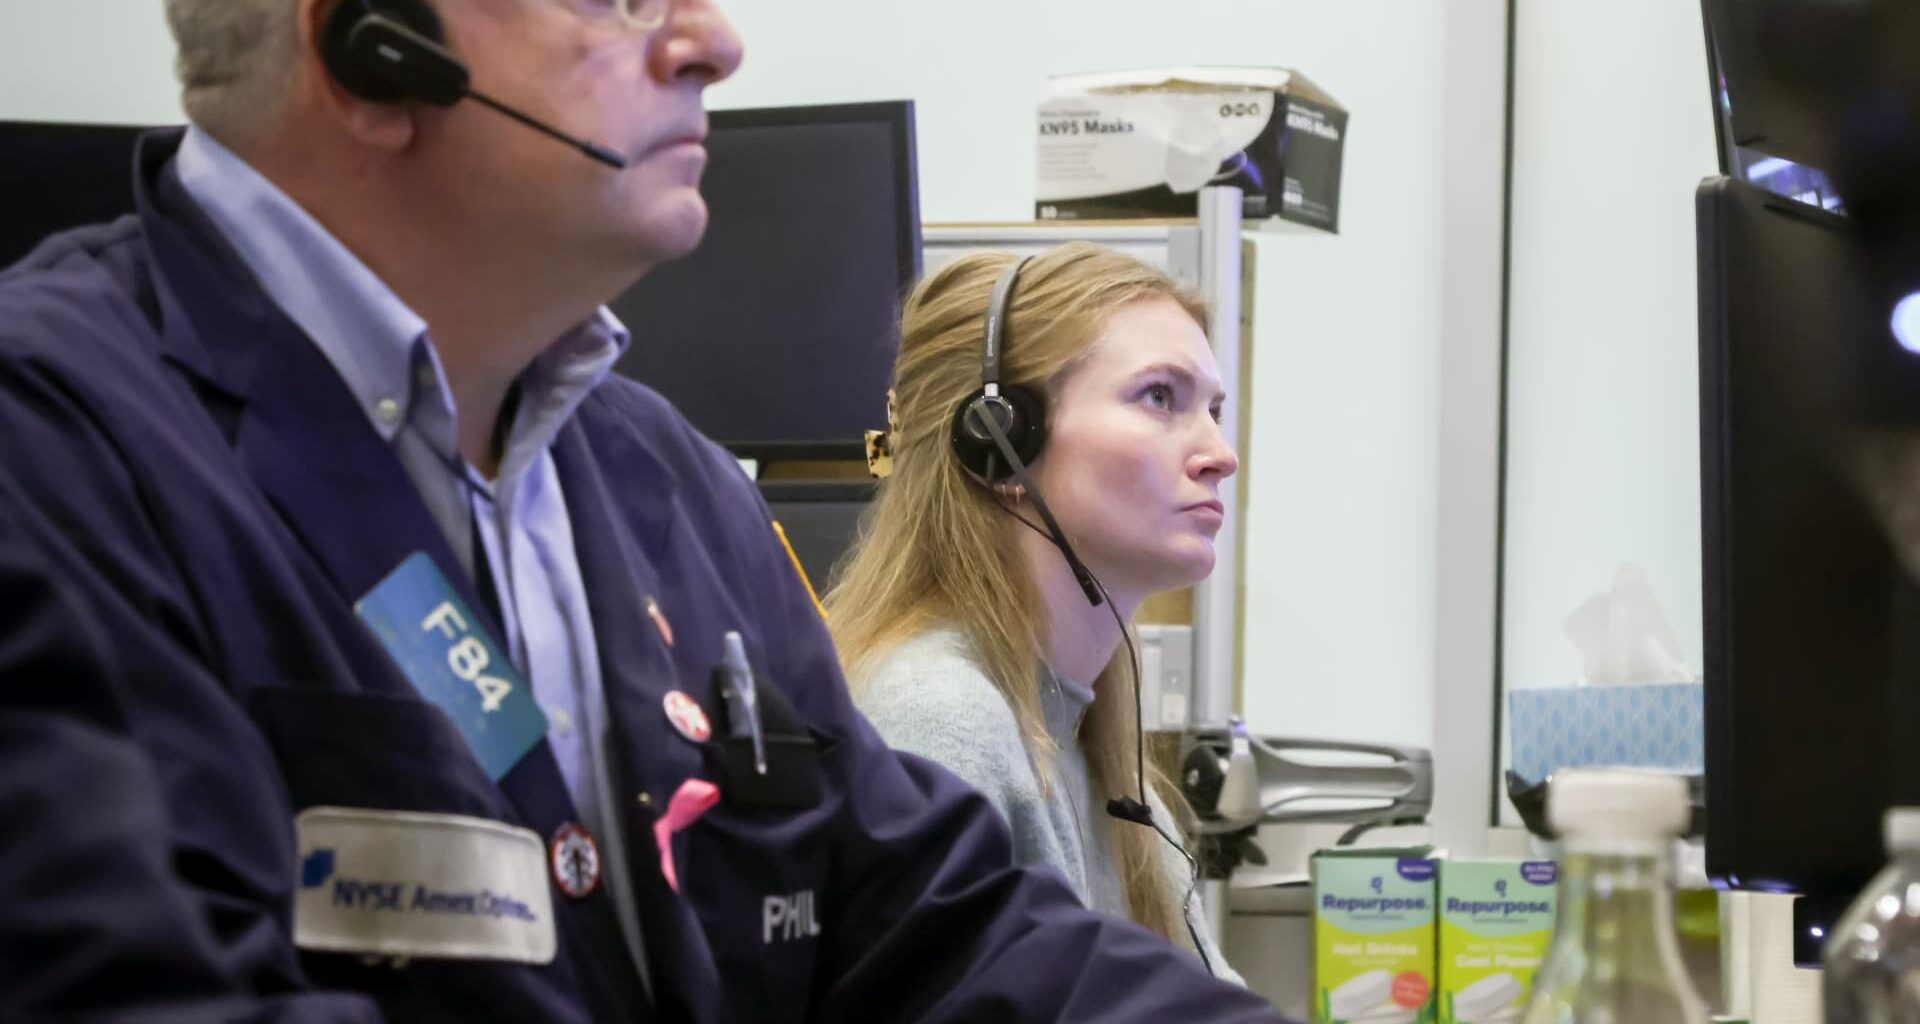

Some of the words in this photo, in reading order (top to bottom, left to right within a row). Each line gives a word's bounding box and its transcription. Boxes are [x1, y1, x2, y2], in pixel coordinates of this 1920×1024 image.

[1084, 118, 1135, 134] Masks
[420, 600, 513, 713] F84
[333, 878, 404, 911] NYSE
[1322, 894, 1426, 911] Repurpose
[1446, 897, 1550, 915] Repurpose
[762, 890, 821, 943] PHIL
